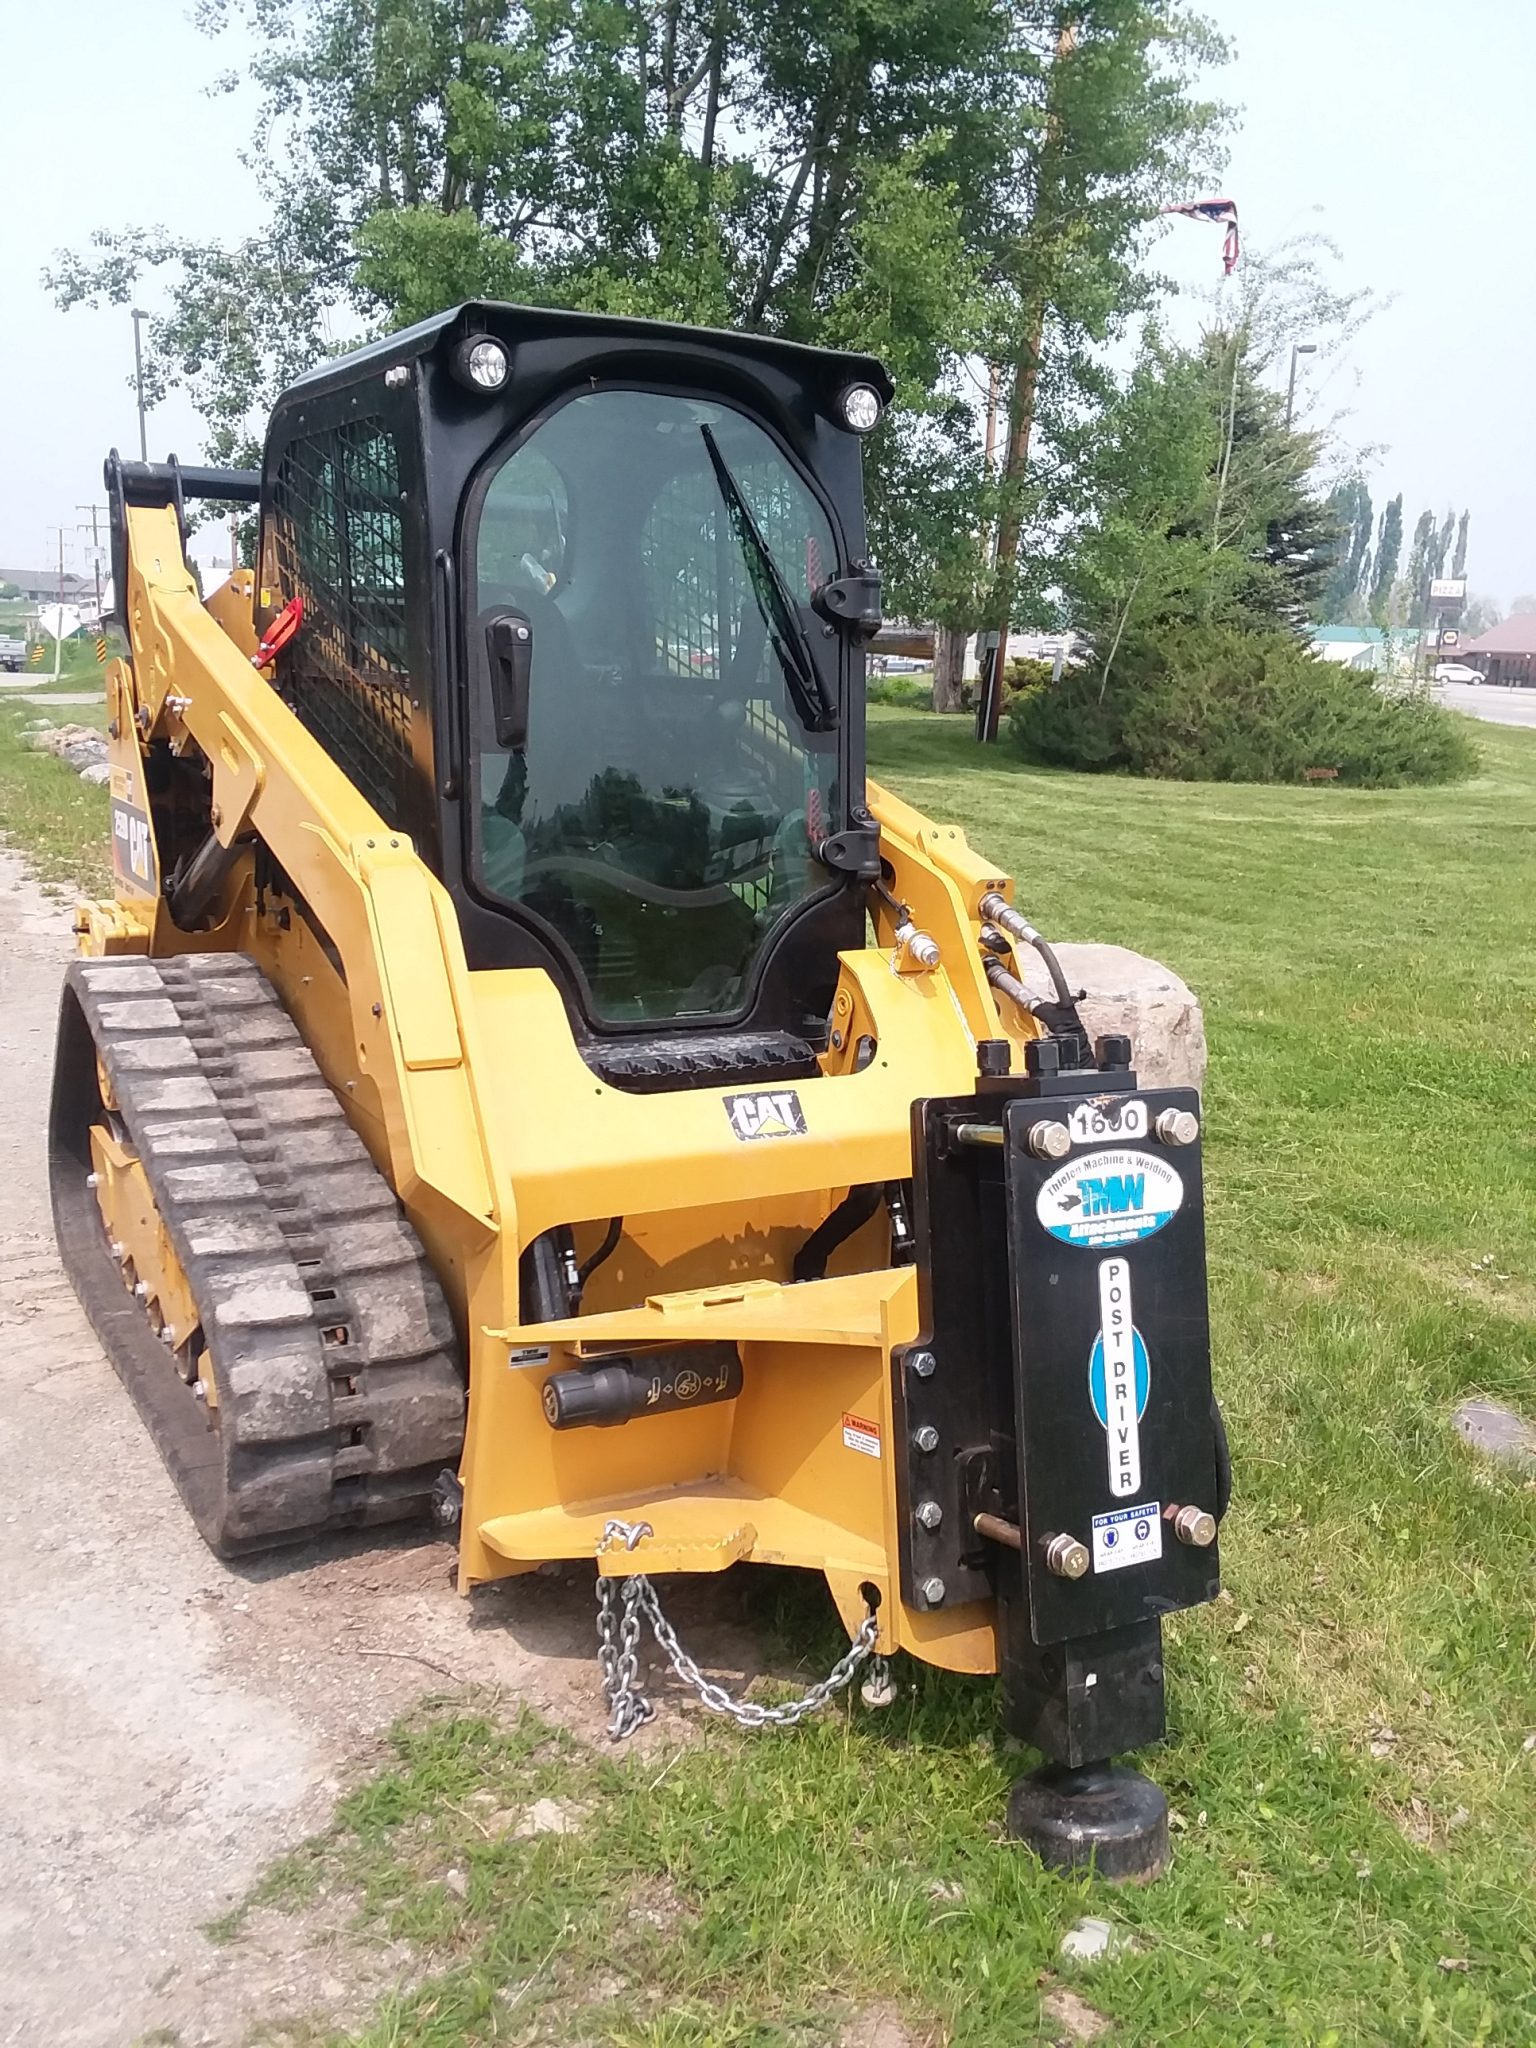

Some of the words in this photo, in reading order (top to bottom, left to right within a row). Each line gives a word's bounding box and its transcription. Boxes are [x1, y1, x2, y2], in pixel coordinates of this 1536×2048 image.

[1433, 585, 1461, 595] PIZZA
[129, 816, 148, 880] CAT
[732, 1094, 798, 1136] CAT
[1083, 1155, 1124, 1171] Machine
[1127, 1156, 1133, 1165] &
[1136, 1156, 1173, 1183] Welding
[1077, 1173, 1145, 1217] TMW
[1109, 1265, 1123, 1347] POST
[851, 1419, 877, 1435] WARNING
[1114, 1361, 1132, 1488] DRIVER
[1095, 1518, 1108, 1527] FOR
[1110, 1513, 1128, 1523] YOUR
